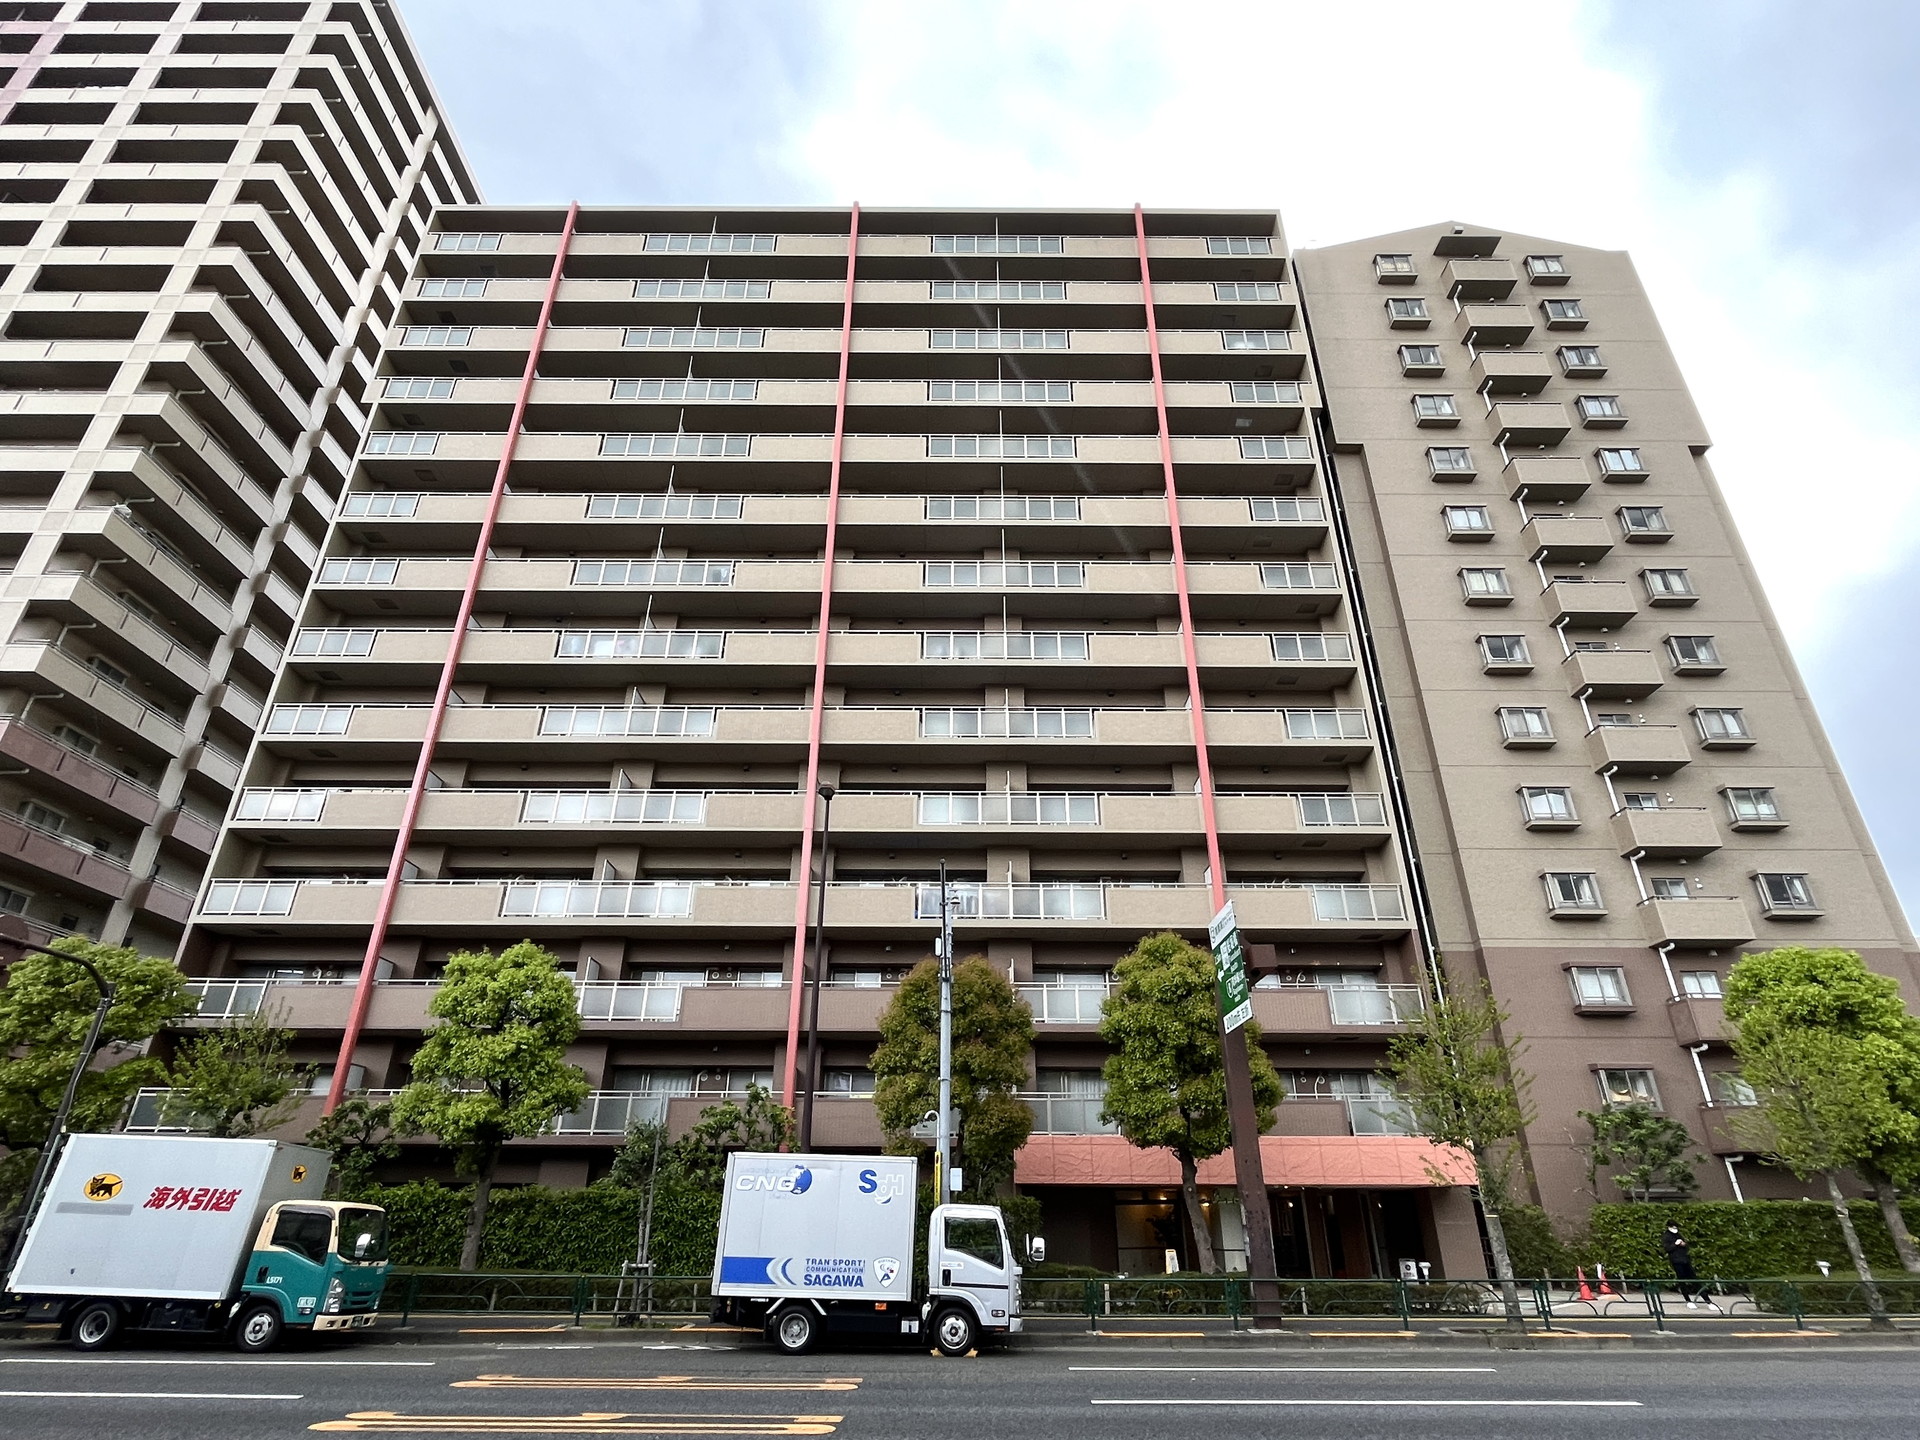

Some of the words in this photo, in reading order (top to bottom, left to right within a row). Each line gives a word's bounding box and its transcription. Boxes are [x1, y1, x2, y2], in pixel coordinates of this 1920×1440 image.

[735, 1174, 797, 1192] CNG
[143, 1186, 242, 1212] 海外引越
[805, 1266, 864, 1274] COMMUNICATION
[803, 1273, 865, 1288] SAGAWA
